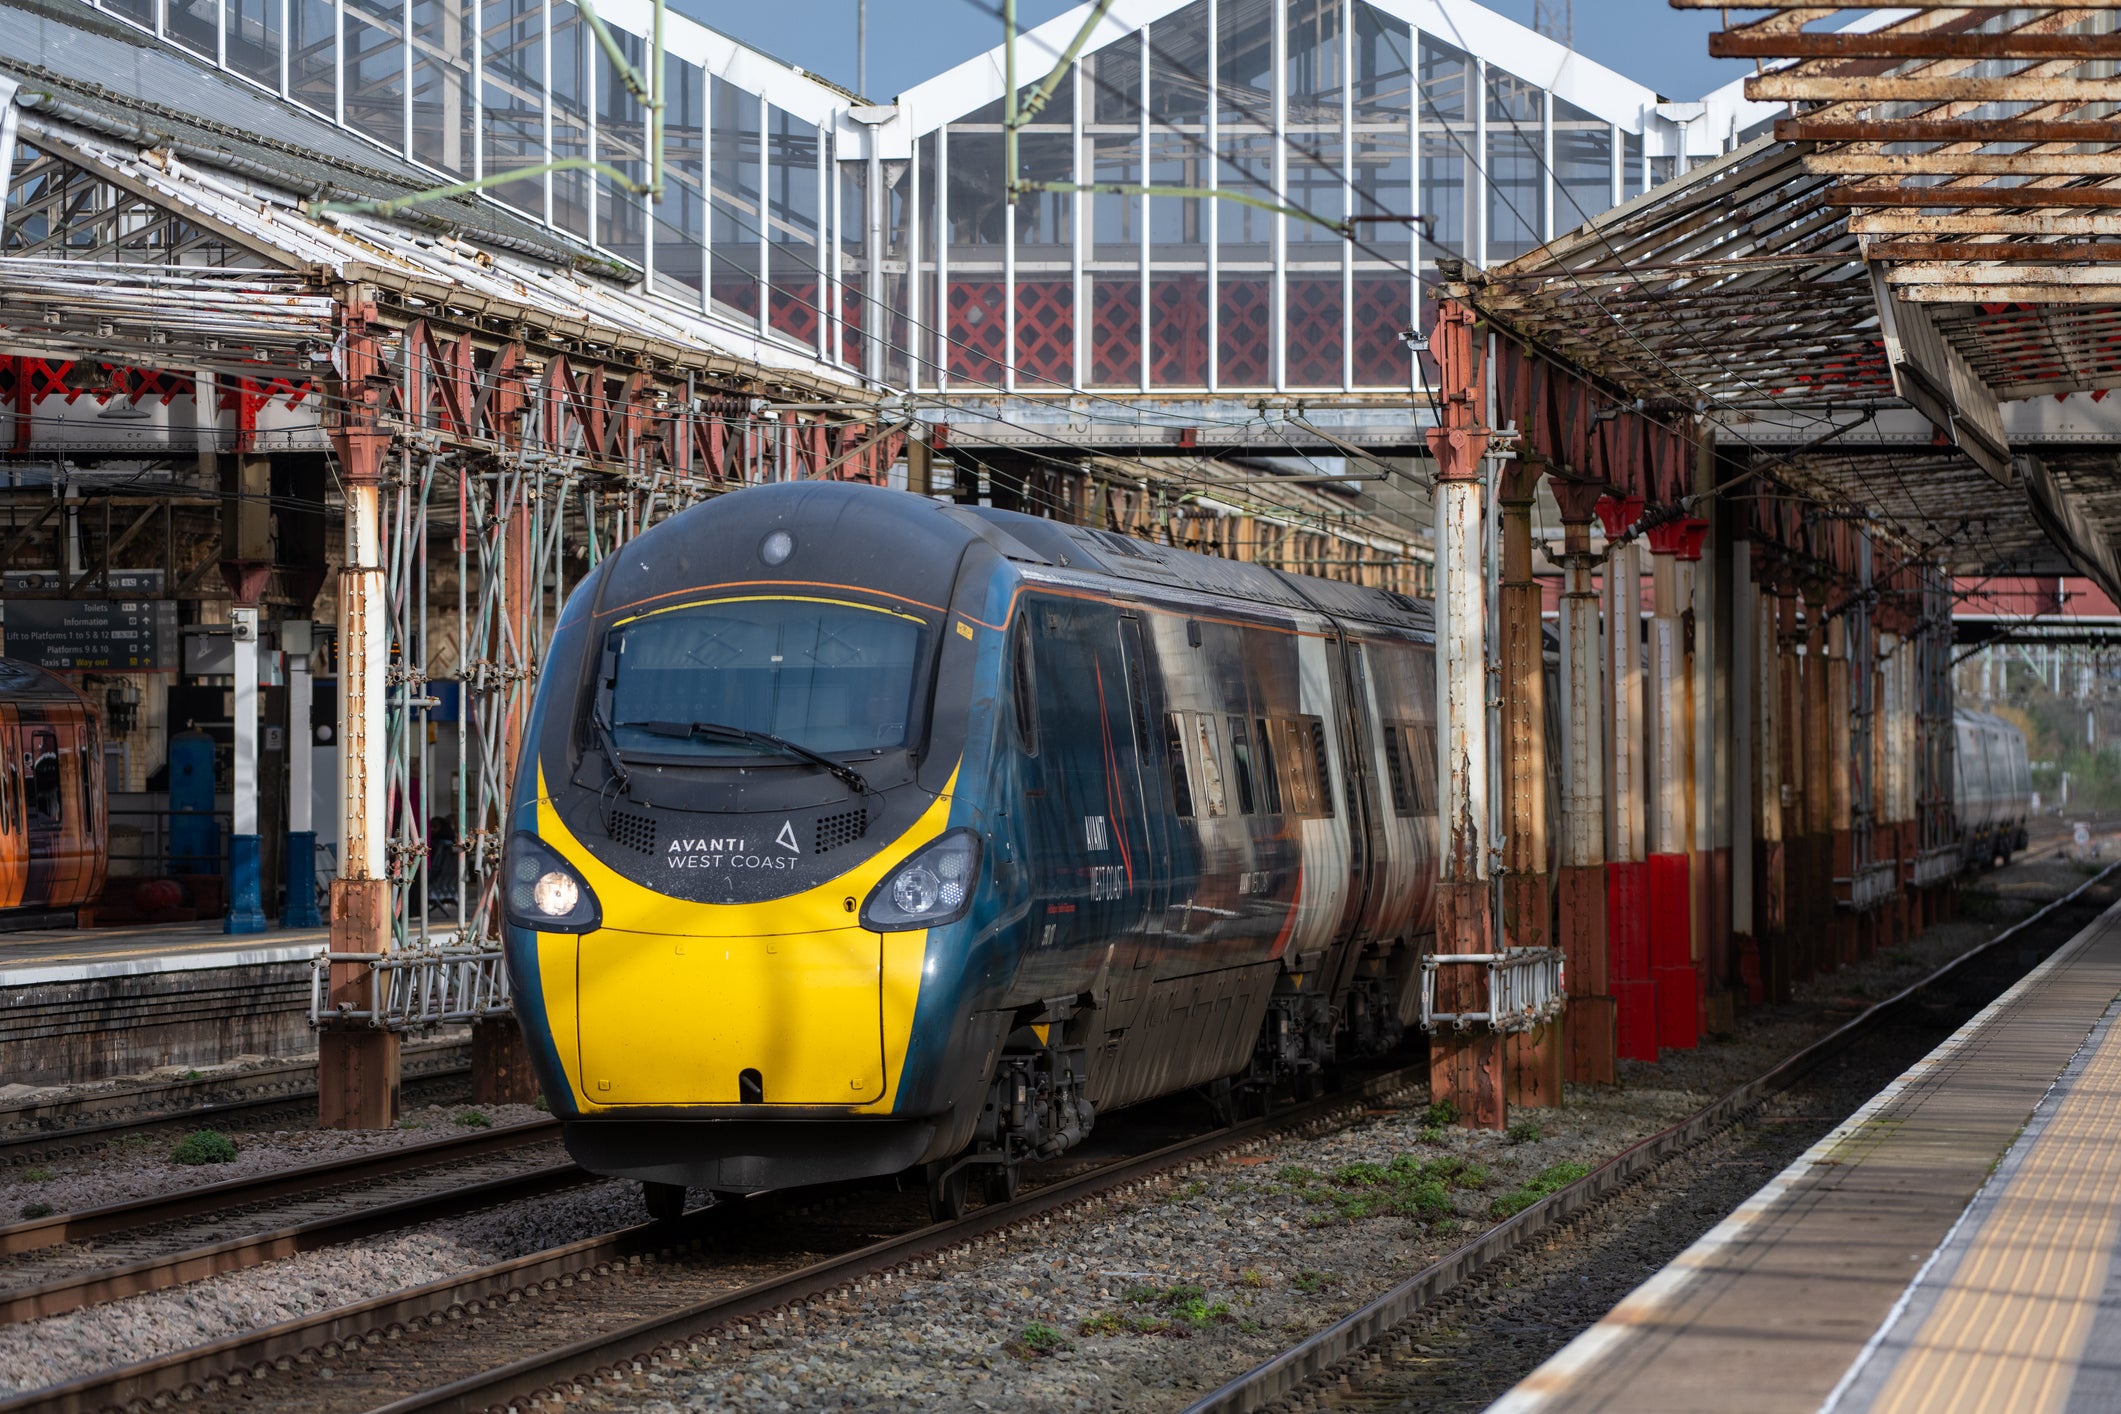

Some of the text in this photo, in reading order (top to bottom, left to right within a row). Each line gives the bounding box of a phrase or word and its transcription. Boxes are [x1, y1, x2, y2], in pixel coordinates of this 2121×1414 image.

[83, 604, 108, 612] Toilets
[63, 618, 109, 626] Information
[7, 632, 19, 640] Lift
[31, 632, 67, 640] Platforms
[85, 631, 91, 639] 5
[92, 631, 98, 639] &
[101, 631, 109, 639] 12
[47, 645, 109, 654] Platforms 9 & 10
[41, 658, 109, 668] Taxis Way out
[271, 730, 278, 740] 5
[1084, 815, 1109, 851] AVANTI
[668, 838, 745, 853] AVANTI
[667, 854, 798, 870] WEST COAST
[1089, 865, 1124, 901] WEST COAST
